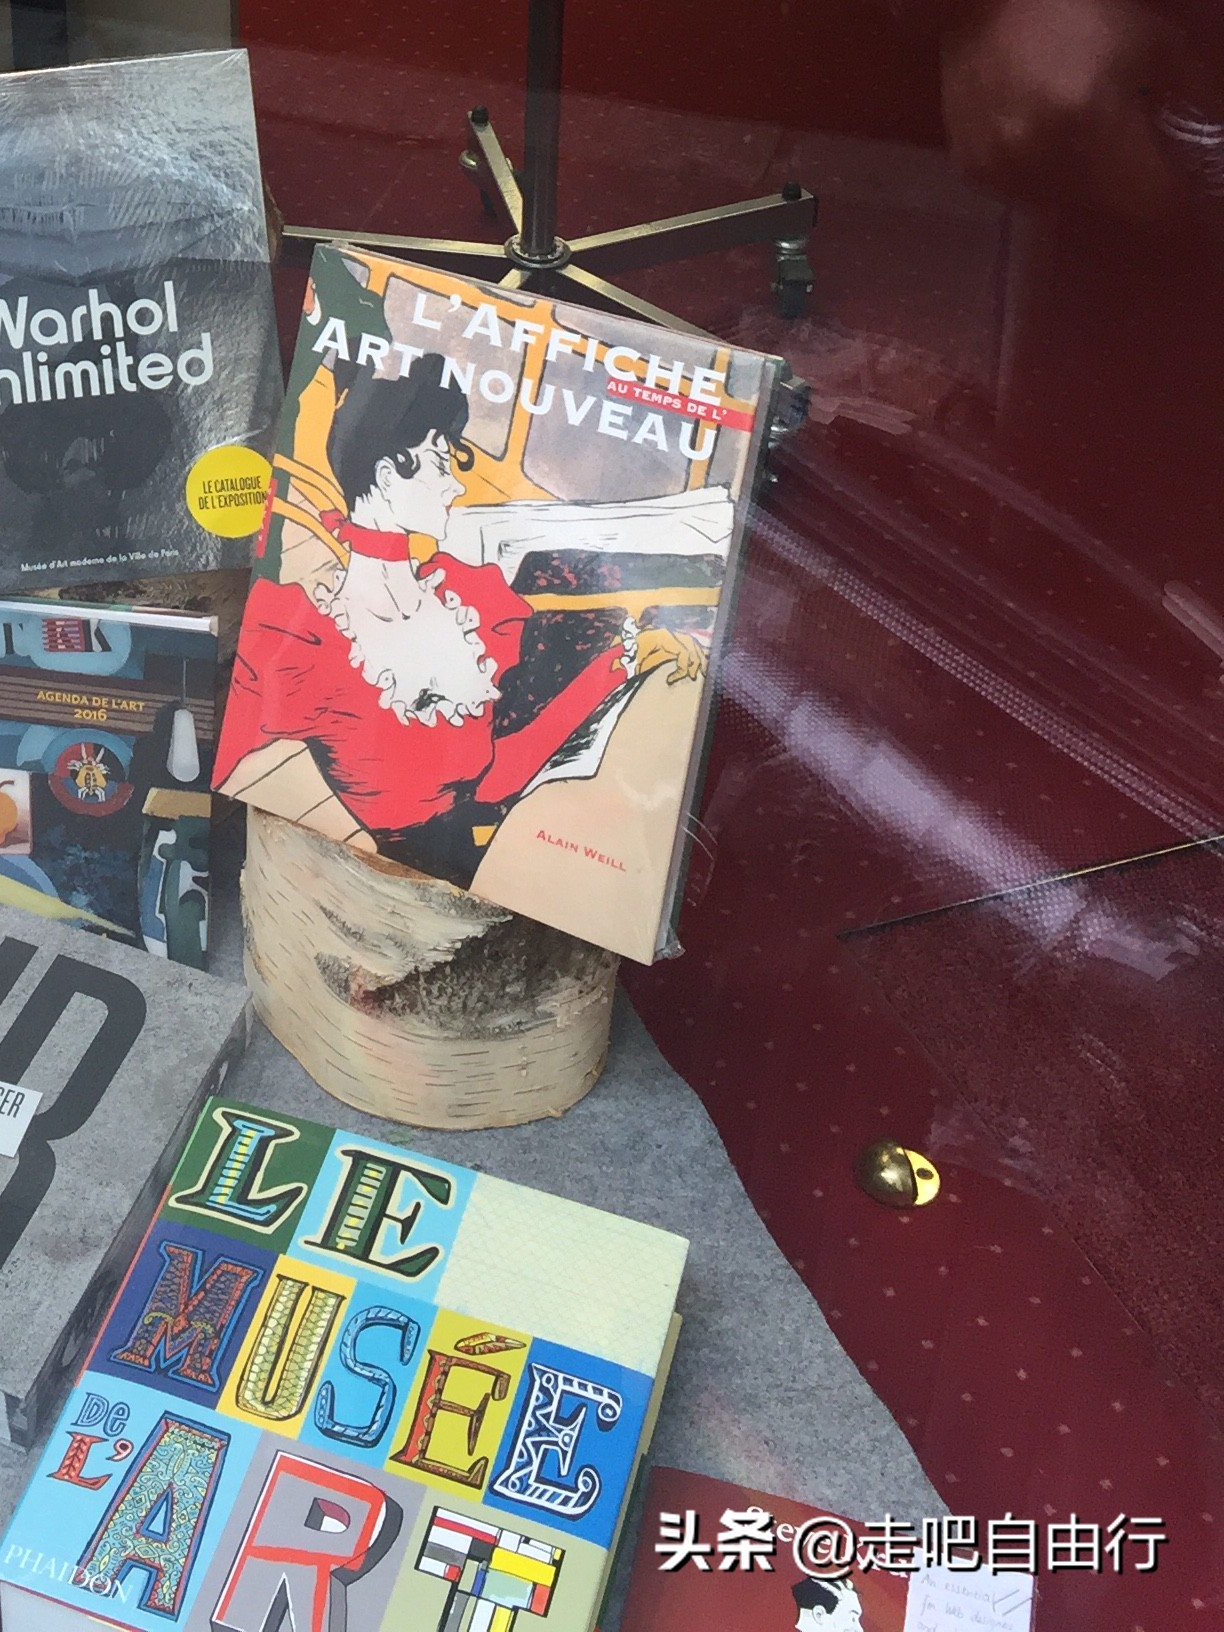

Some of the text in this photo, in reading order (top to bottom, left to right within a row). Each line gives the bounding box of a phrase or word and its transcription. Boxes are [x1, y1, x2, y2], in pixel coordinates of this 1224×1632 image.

[412, 293, 727, 405] L'AFFICHE
[312, 318, 718, 462] ART NOUVEAU
[606, 379, 728, 421] AU TEMPS DE L'
[198, 491, 268, 510] DE L'EXPOSITION
[202, 476, 262, 494] LE CATALOGUE
[21, 549, 179, 572] Musée d'Art moderne de la Ville de Paris
[36, 690, 145, 712] AGENDA DE L'ART
[74, 708, 107, 721] 2016
[537, 830, 626, 872] ALAIN WEILL
[168, 1107, 457, 1284] LE
[107, 1241, 625, 1520] MUSÉE
[3, 1544, 133, 1607] PHAIDON
